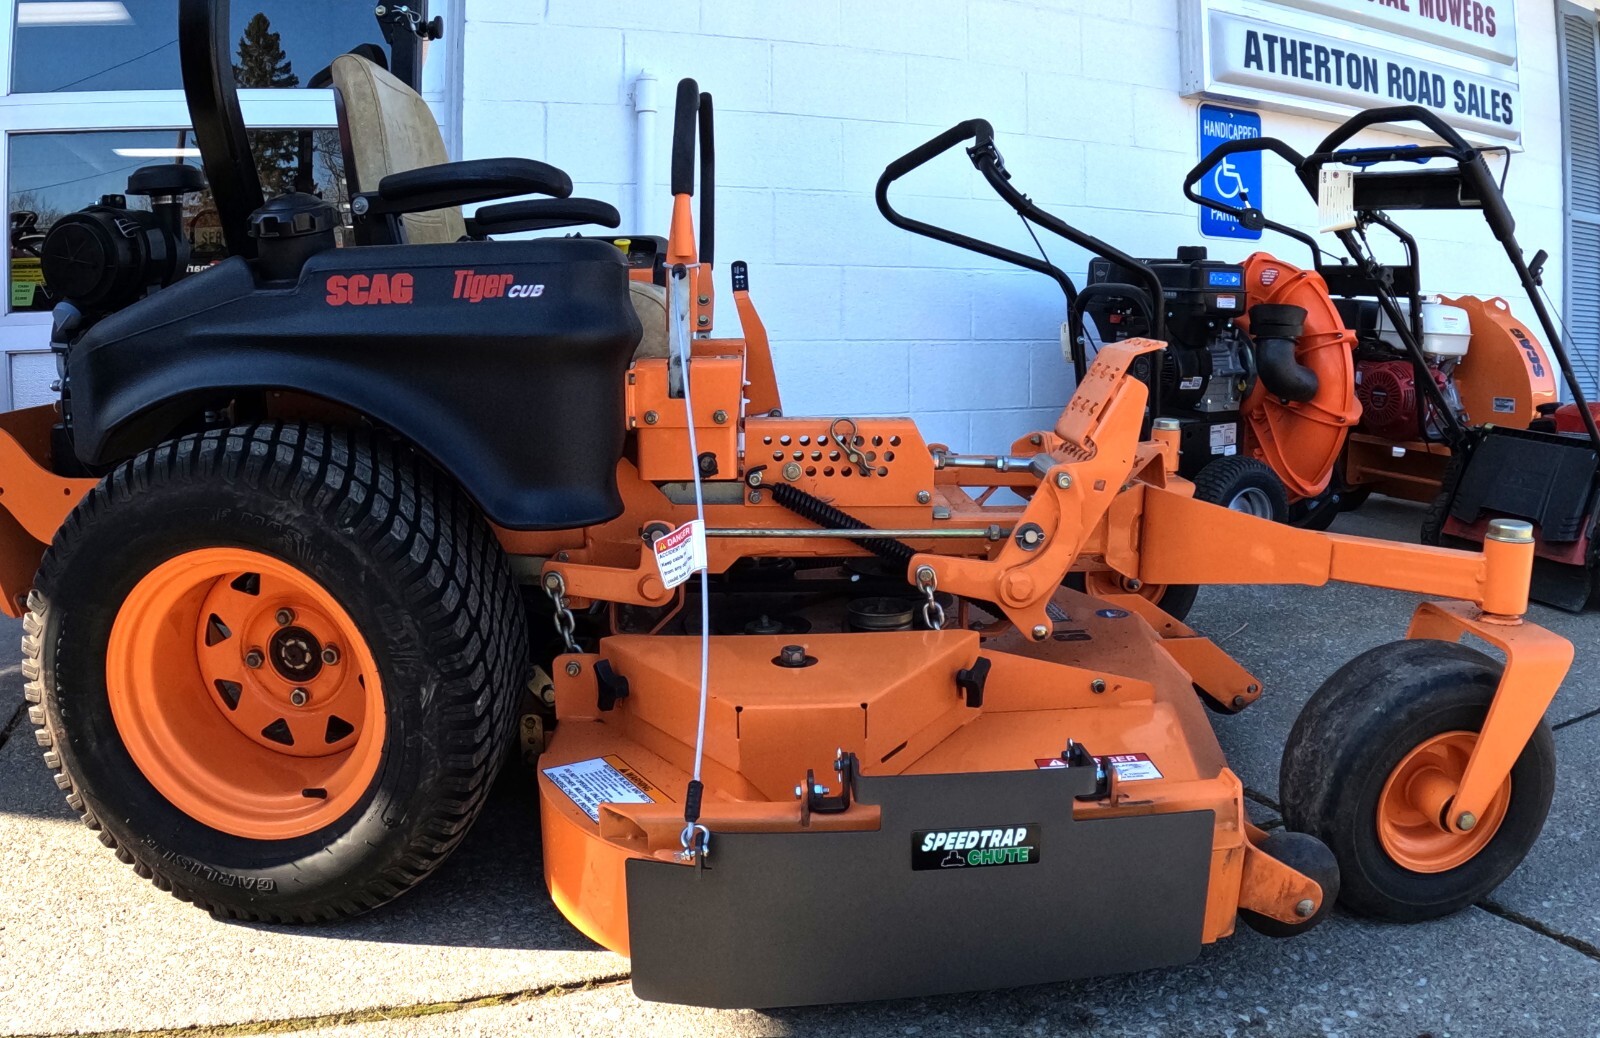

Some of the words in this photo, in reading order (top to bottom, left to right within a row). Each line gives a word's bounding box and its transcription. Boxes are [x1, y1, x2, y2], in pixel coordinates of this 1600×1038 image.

[1419, 0, 1497, 37] MOWERS
[1244, 30, 1379, 94] ATHERTON
[1387, 62, 1446, 109] ROAD
[1453, 79, 1514, 125] SALES
[1203, 119, 1259, 140] HANDICAPPED
[326, 272, 414, 306] SCAG
[453, 269, 514, 303] Tiger
[508, 284, 545, 298] CUB
[1509, 328, 1545, 378] SCAG
[667, 527, 690, 547] DANGER
[625, 772, 653, 792] WARNING
[921, 828, 1028, 852] SPEEDTRAP
[967, 847, 1030, 866] CHUTE
